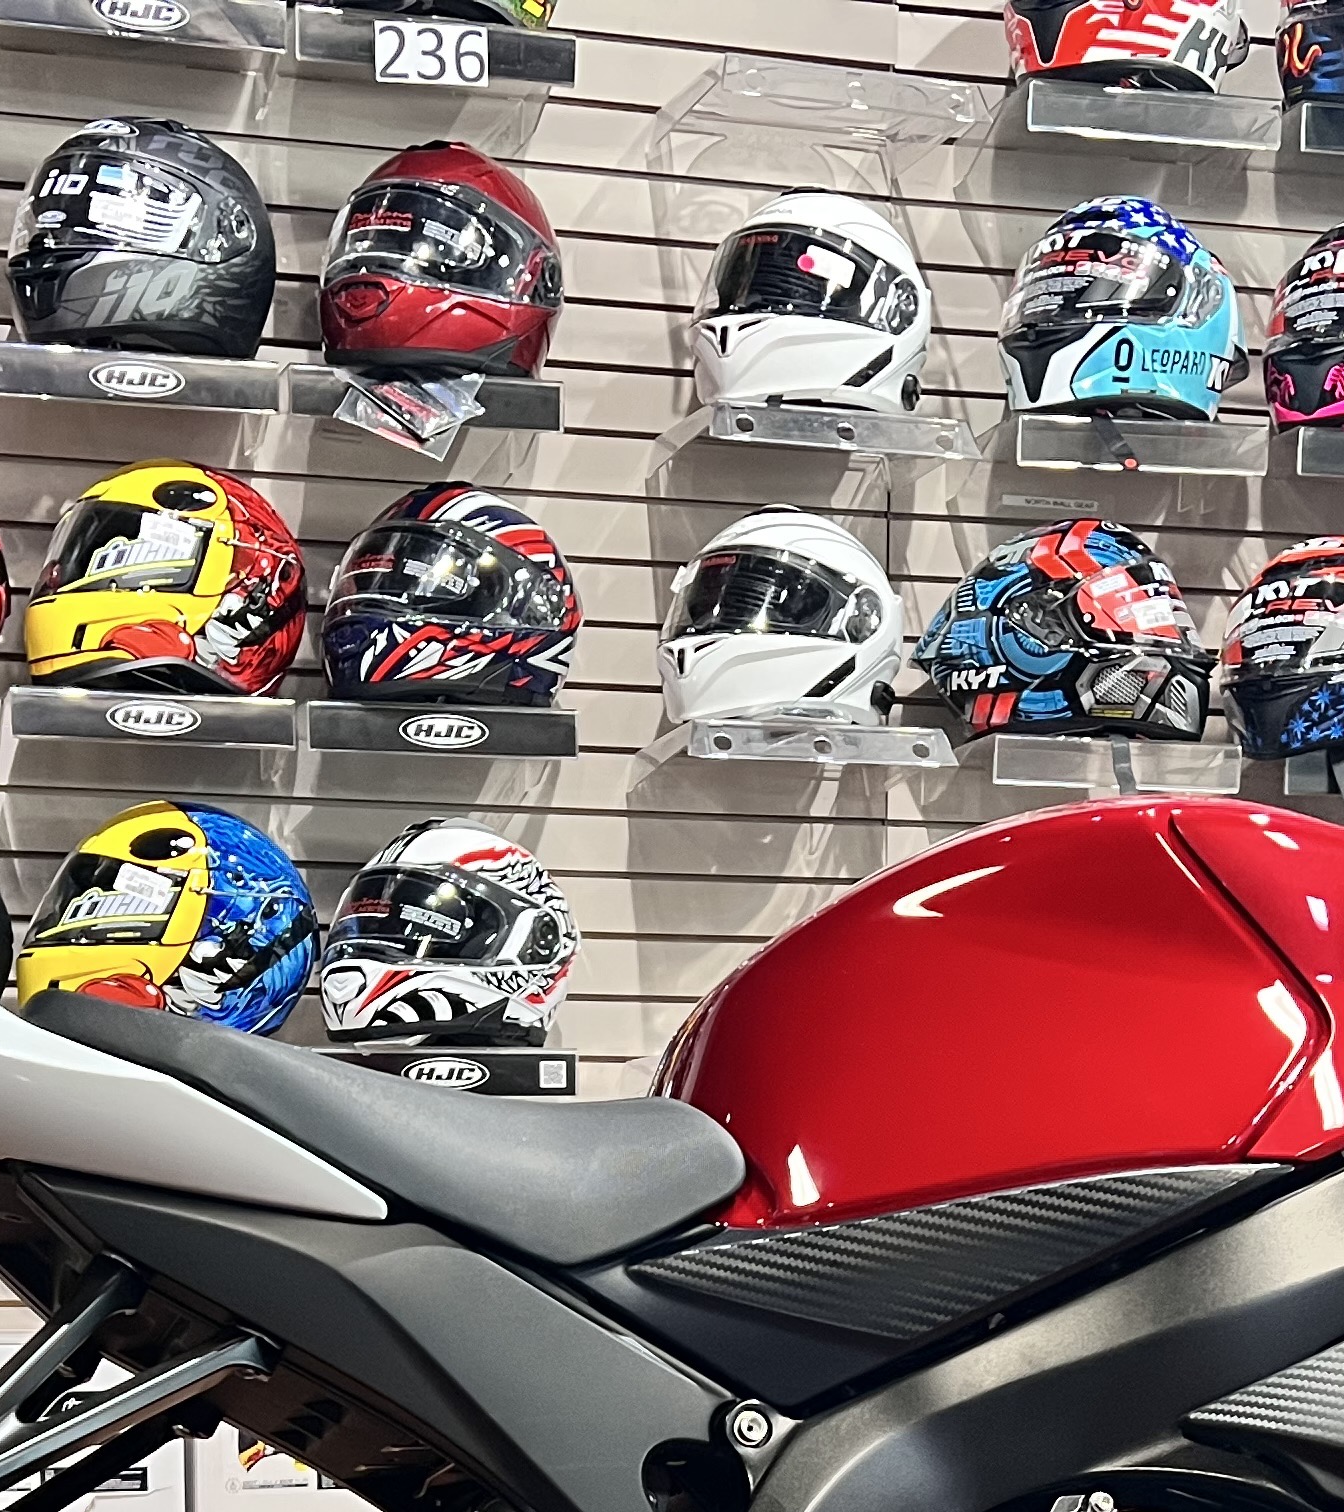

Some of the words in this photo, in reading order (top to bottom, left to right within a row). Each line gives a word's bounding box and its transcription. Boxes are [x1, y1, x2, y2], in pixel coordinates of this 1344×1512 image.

[375, 26, 486, 83] 236
[1141, 347, 1206, 376] LEOPARD
[951, 665, 1006, 690] KYT
